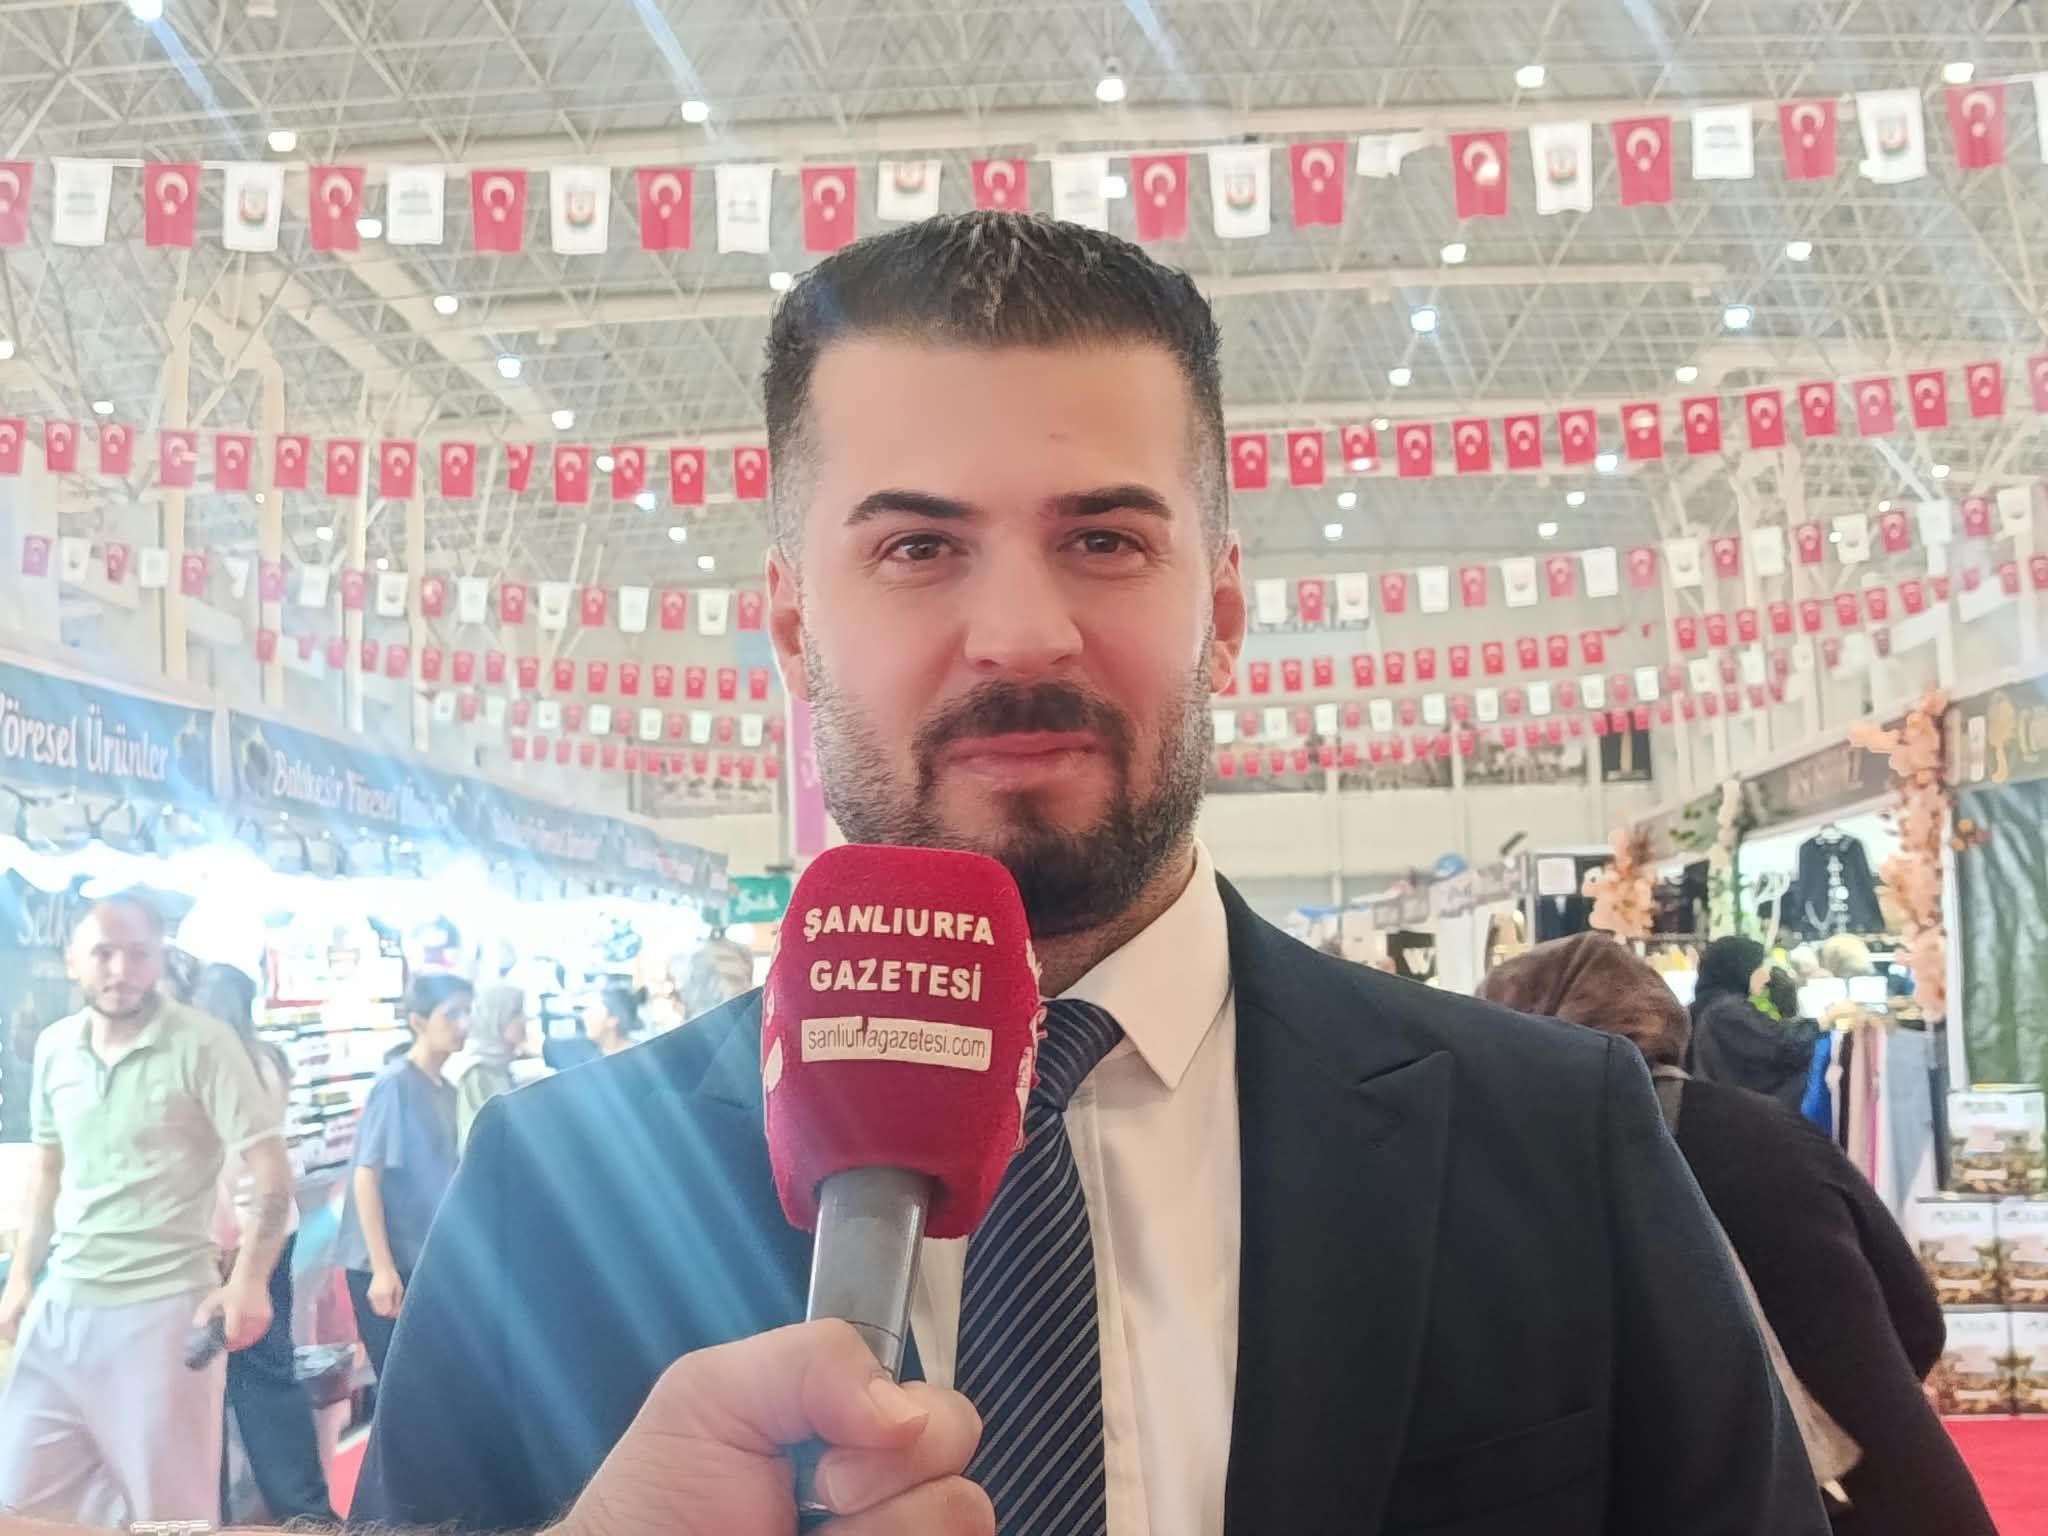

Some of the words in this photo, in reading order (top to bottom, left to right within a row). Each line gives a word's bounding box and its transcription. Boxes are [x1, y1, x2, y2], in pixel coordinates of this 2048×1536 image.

[85, 702, 168, 782] Ürünler
[803, 905, 995, 945] ŞANLIURFA
[809, 958, 982, 1002] GAZETESİ
